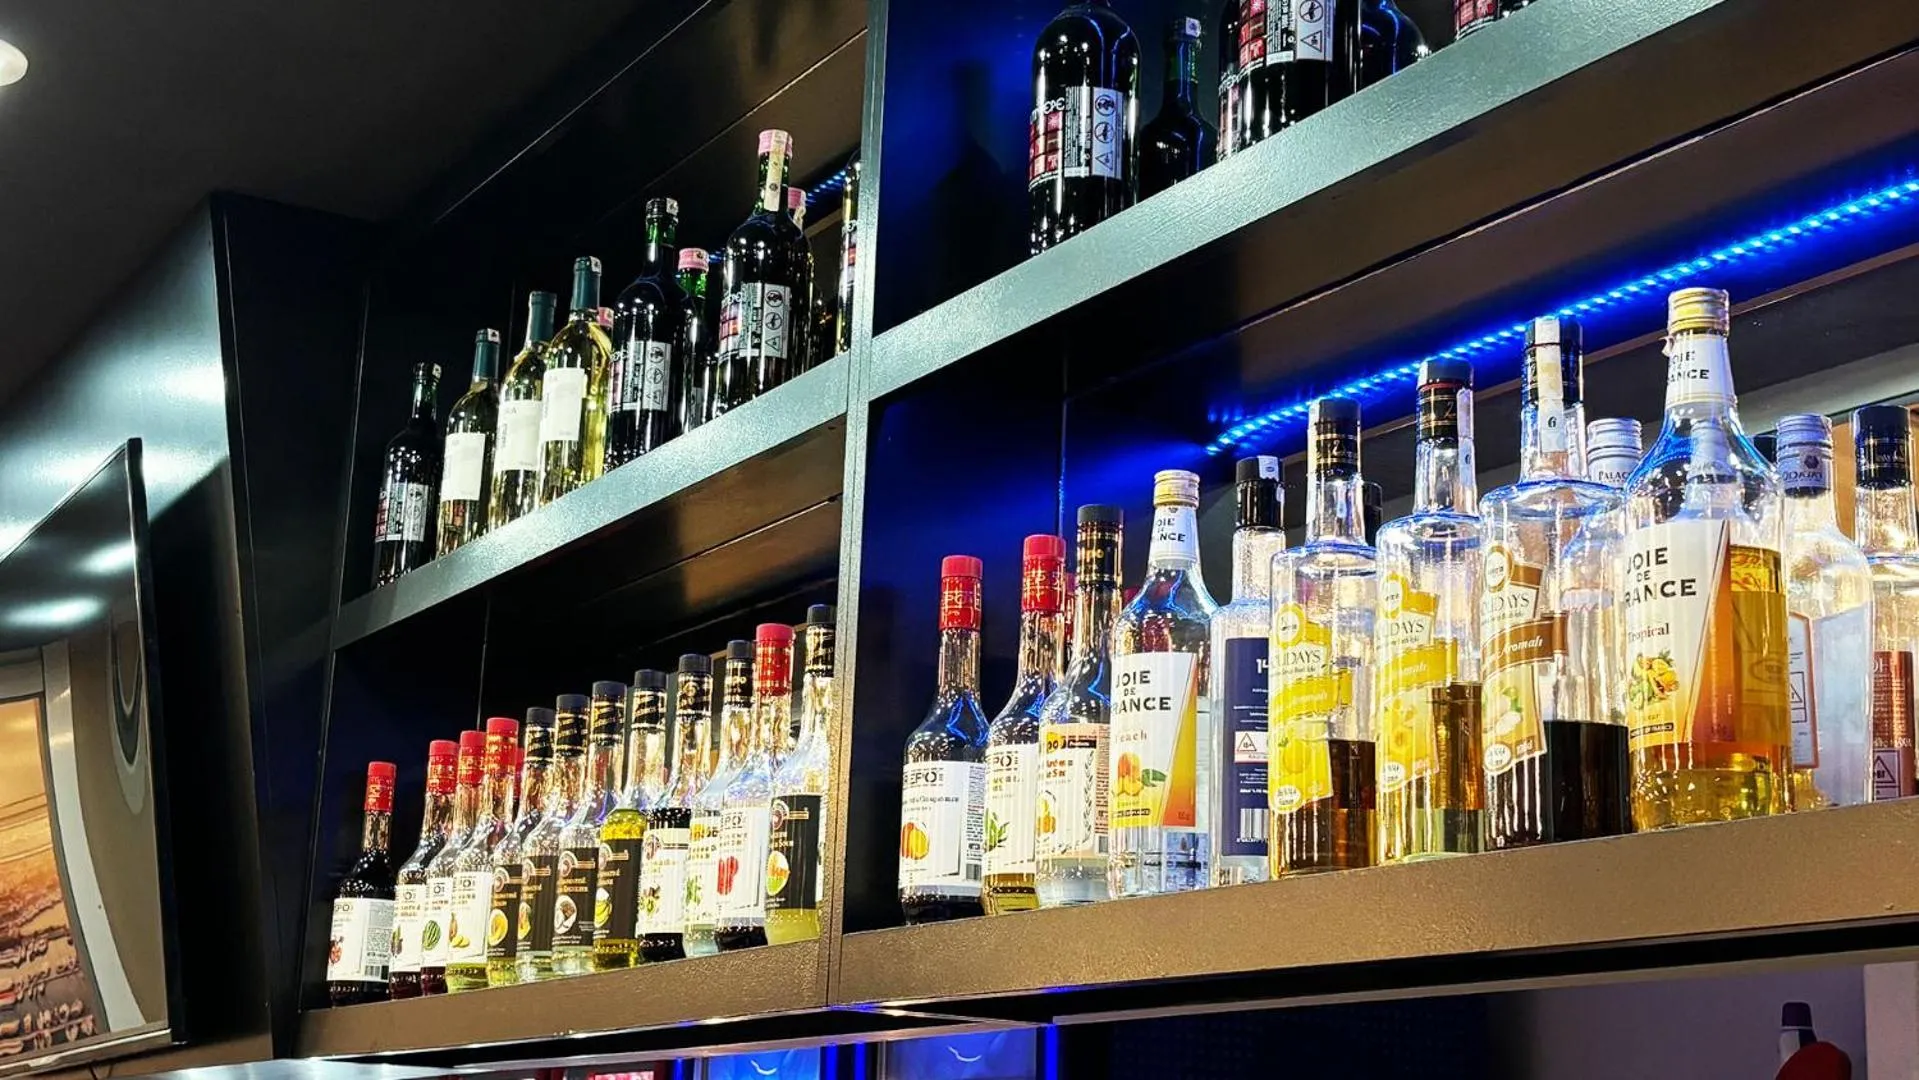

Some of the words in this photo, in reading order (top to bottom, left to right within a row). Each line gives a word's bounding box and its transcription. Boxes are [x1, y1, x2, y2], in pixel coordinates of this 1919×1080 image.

[1626, 547, 1668, 574] JOIE
[1115, 669, 1151, 689] JOIE
[1115, 730, 1148, 744] each
